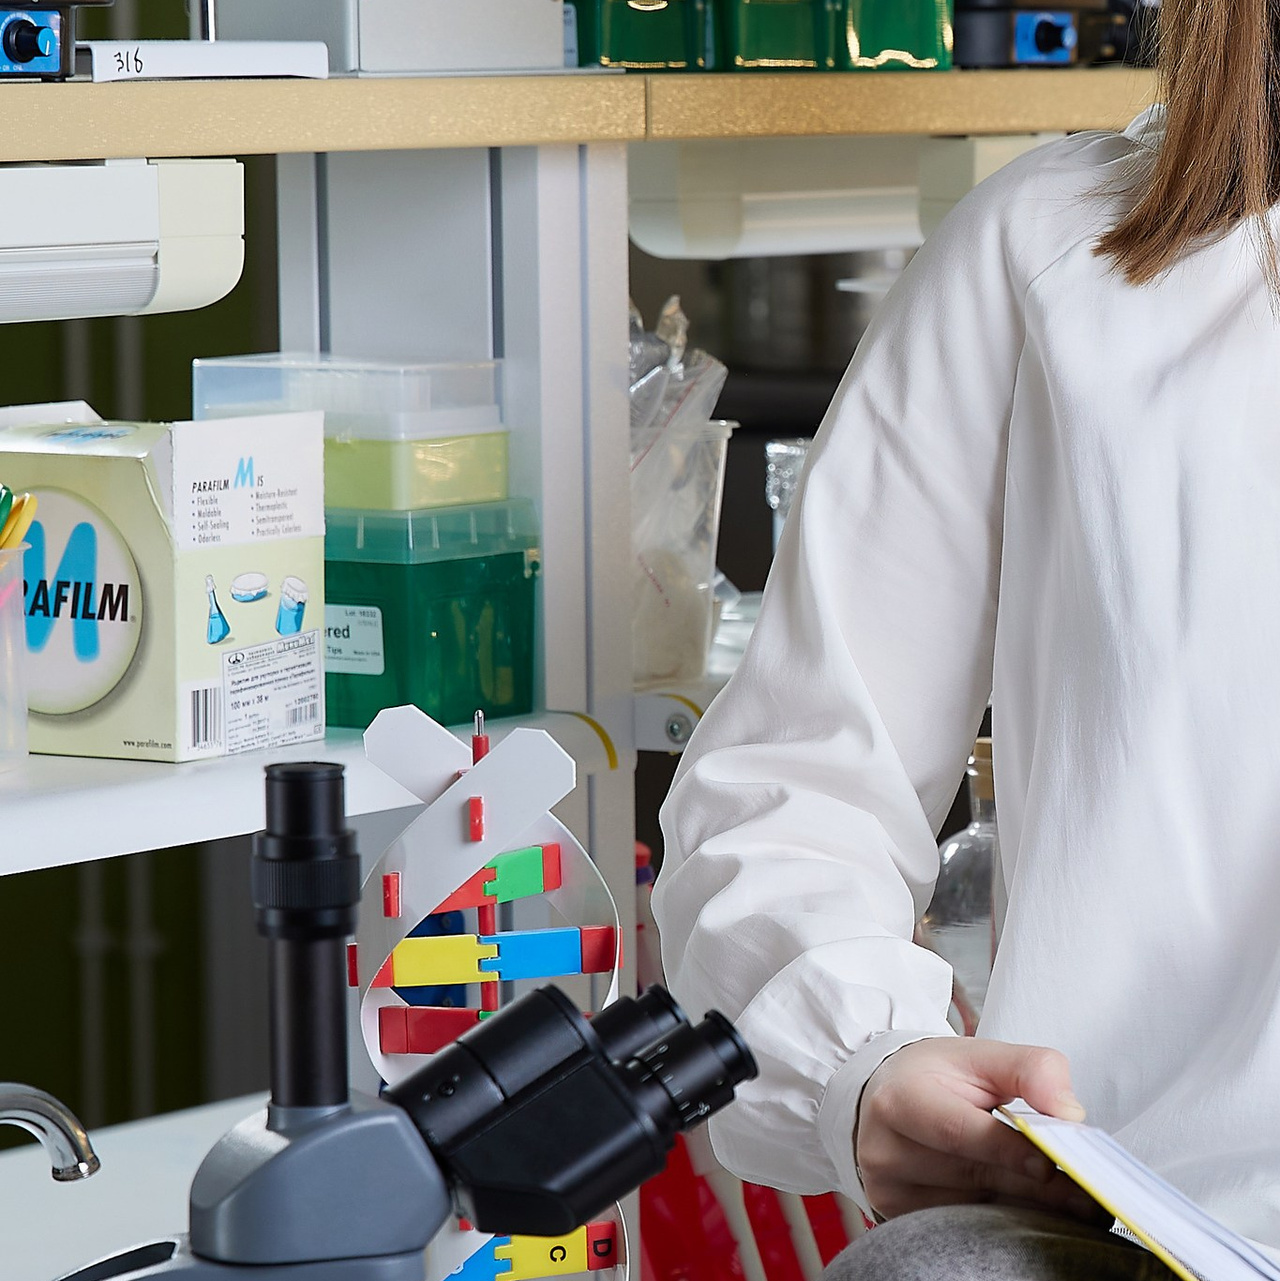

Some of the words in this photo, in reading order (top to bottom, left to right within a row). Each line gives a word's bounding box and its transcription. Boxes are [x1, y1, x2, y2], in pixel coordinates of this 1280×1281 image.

[191, 479, 230, 493] PARAFILM
[233, 456, 255, 489] M
[197, 496, 219, 507] Flexible
[197, 508, 222, 518] Moldable
[197, 520, 230, 531] Self-Sealing
[23, 579, 129, 622] AFILM
[123, 739, 173, 749] www.parafilm.com
[549, 1245, 567, 1263] C
